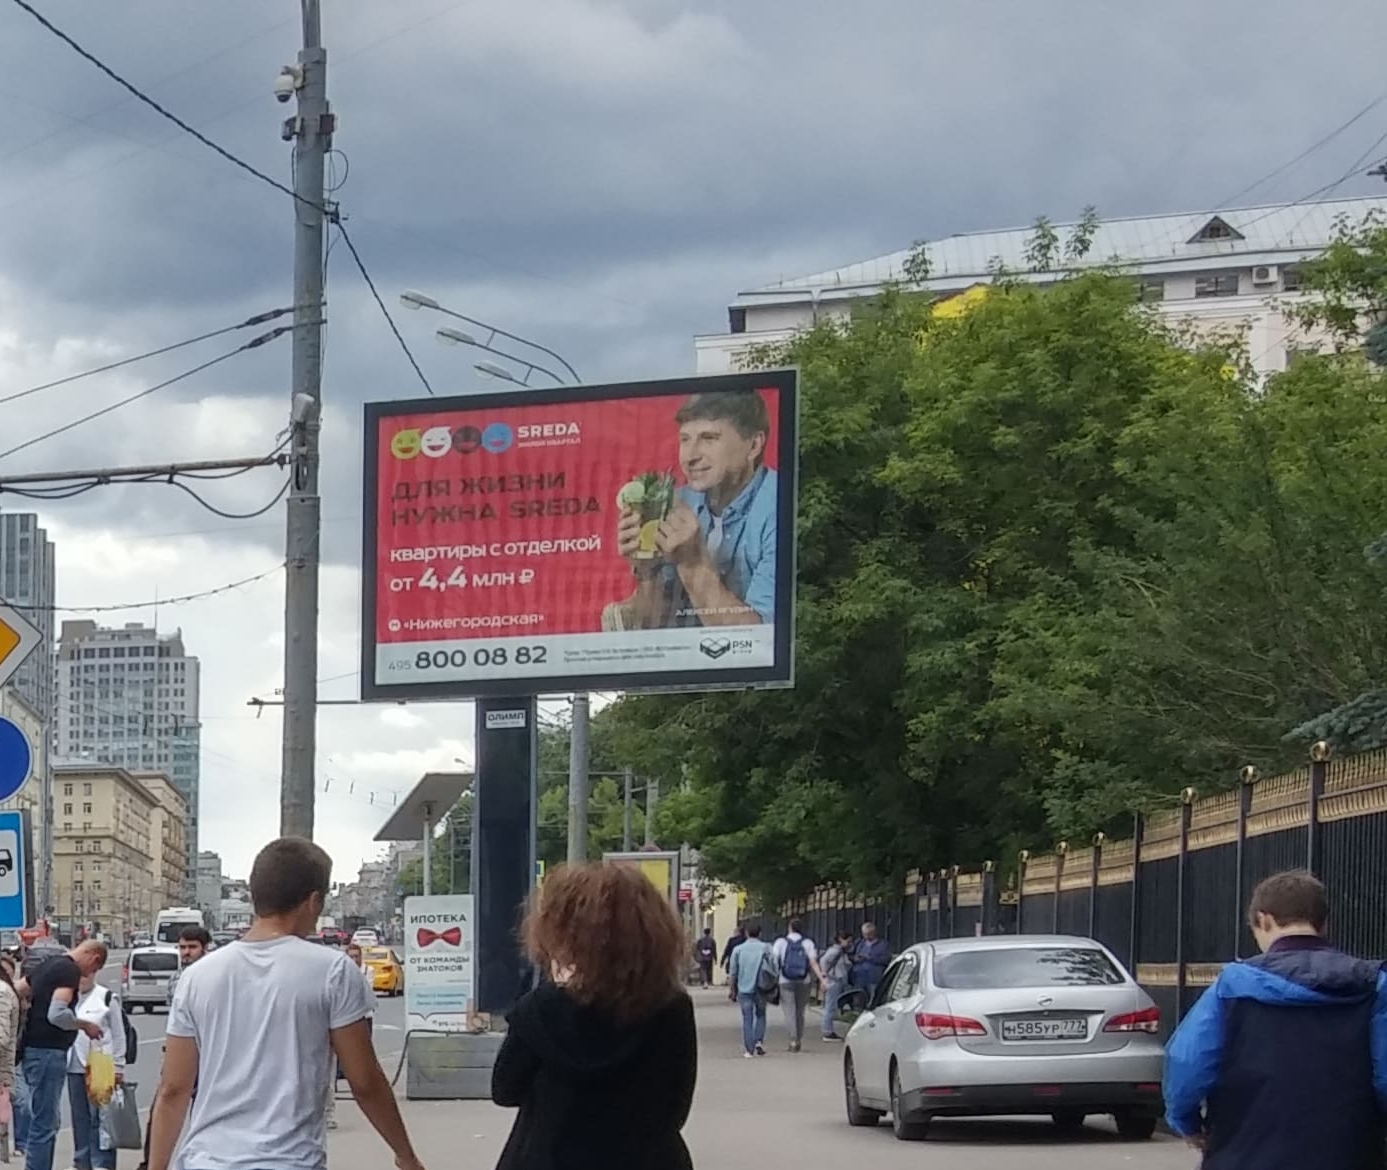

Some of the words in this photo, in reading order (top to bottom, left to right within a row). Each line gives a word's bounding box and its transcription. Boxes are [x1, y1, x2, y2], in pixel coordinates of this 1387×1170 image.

[517, 422, 580, 438] SREDA
[391, 480, 450, 503] ДЛЯ
[460, 472, 566, 496] ЖИЗНИ
[391, 503, 497, 526] НУЖНА
[509, 496, 601, 519] SREDA
[390, 544, 486, 563] квартиры
[490, 543, 500, 556] с
[504, 534, 602, 556] отделкой
[390, 578, 414, 592] от
[418, 566, 467, 592] 4,4
[472, 571, 515, 587] млн
[404, 613, 545, 631] «Нижегородская»
[732, 640, 753, 649] PSN
[388, 660, 412, 671] 495
[415, 650, 467, 669] 800
[474, 647, 508, 666] 08
[515, 646, 548, 665] 82
[410, 914, 467, 924] ИПОТЕКА
